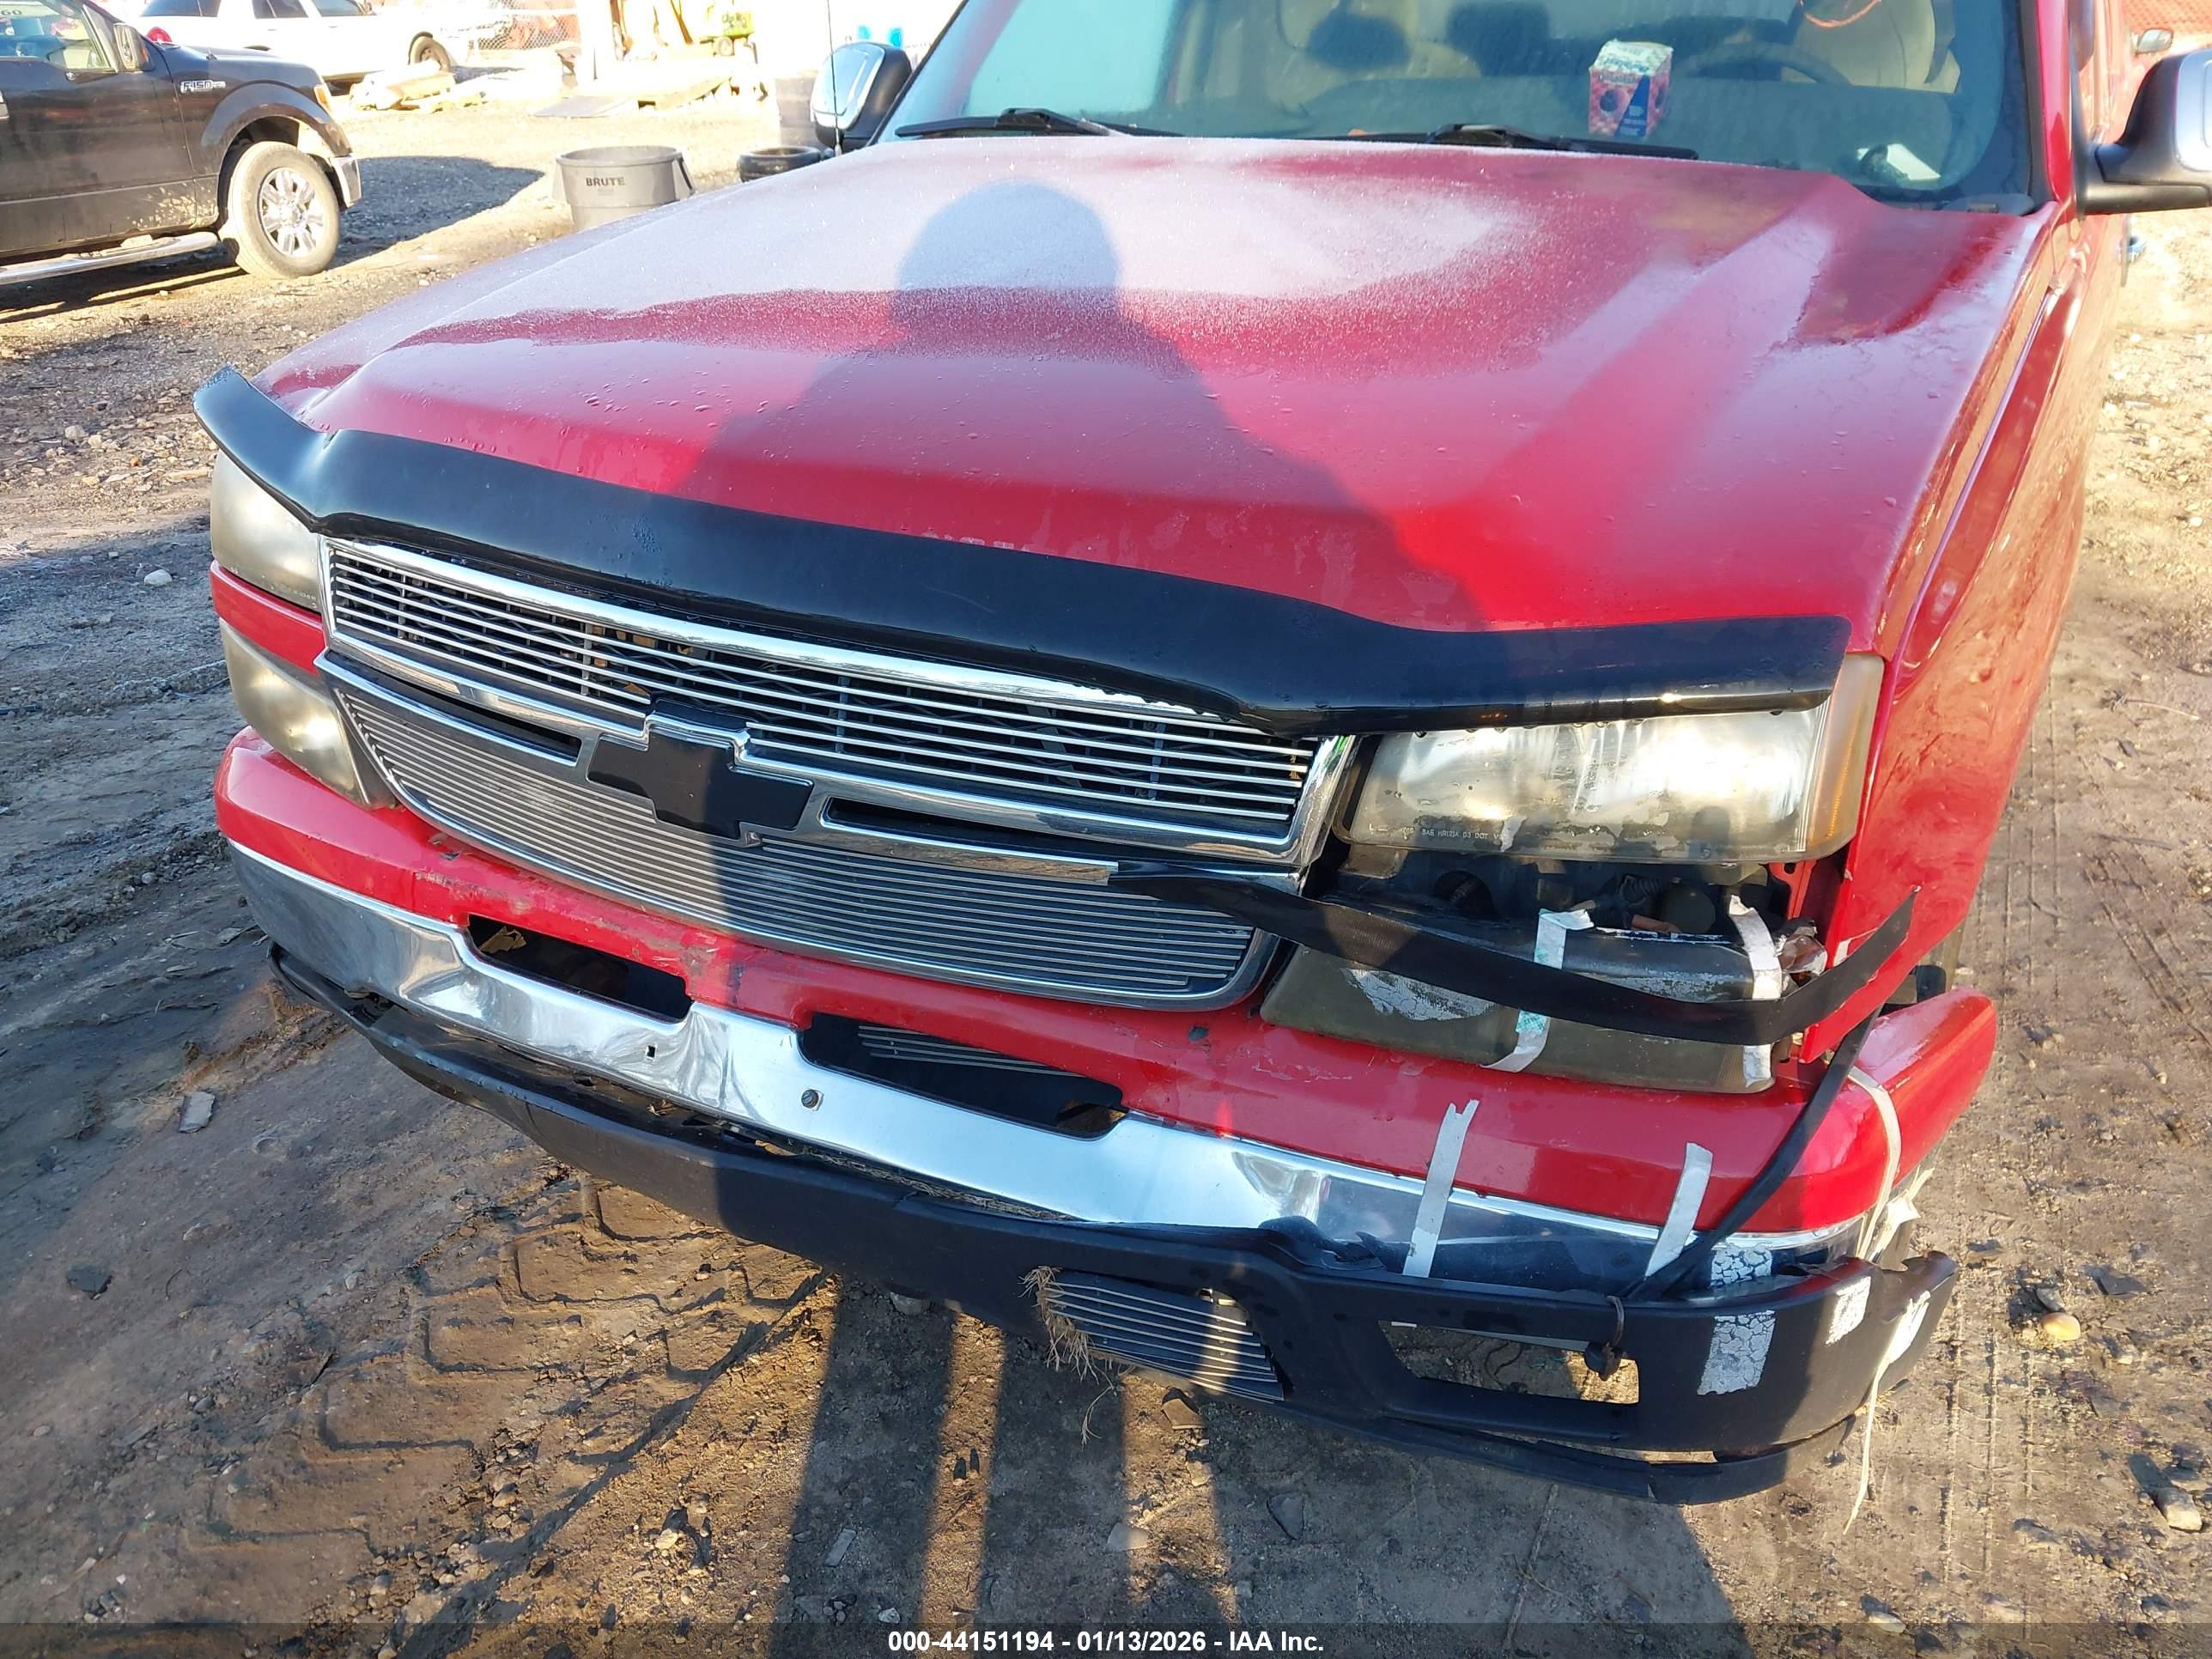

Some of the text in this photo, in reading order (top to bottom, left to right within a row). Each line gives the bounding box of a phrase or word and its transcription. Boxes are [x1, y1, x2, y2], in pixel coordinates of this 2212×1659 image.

[585, 177, 626, 186] BRUTE
[1421, 828, 1435, 837] SAE
[1474, 831, 1489, 840] DOT
